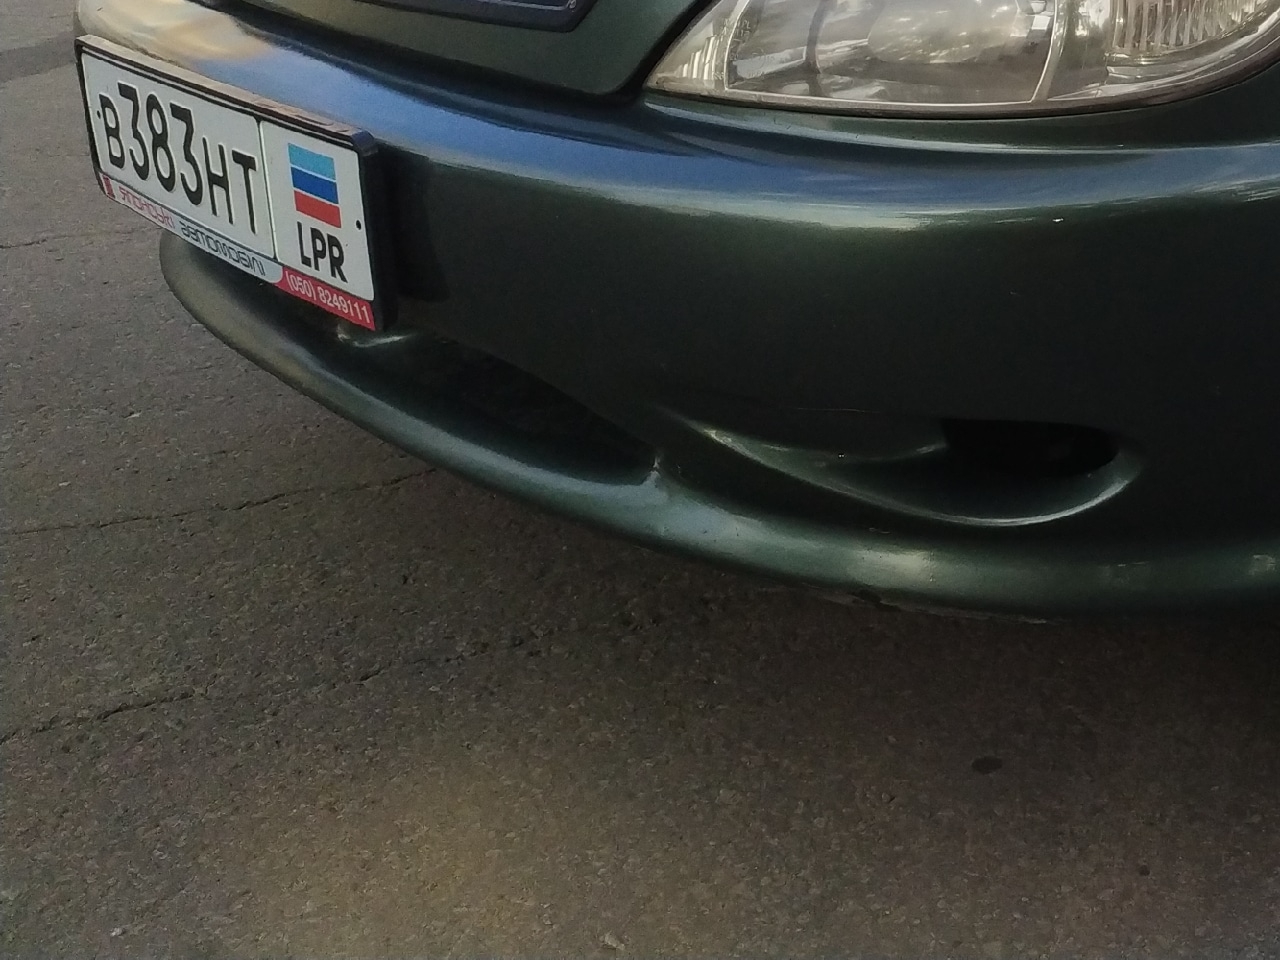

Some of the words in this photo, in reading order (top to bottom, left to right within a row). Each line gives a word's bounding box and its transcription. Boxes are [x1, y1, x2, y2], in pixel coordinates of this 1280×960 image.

[297, 221, 348, 284] LPR
[285, 270, 317, 300] (050)
[317, 285, 371, 324] 8249111
